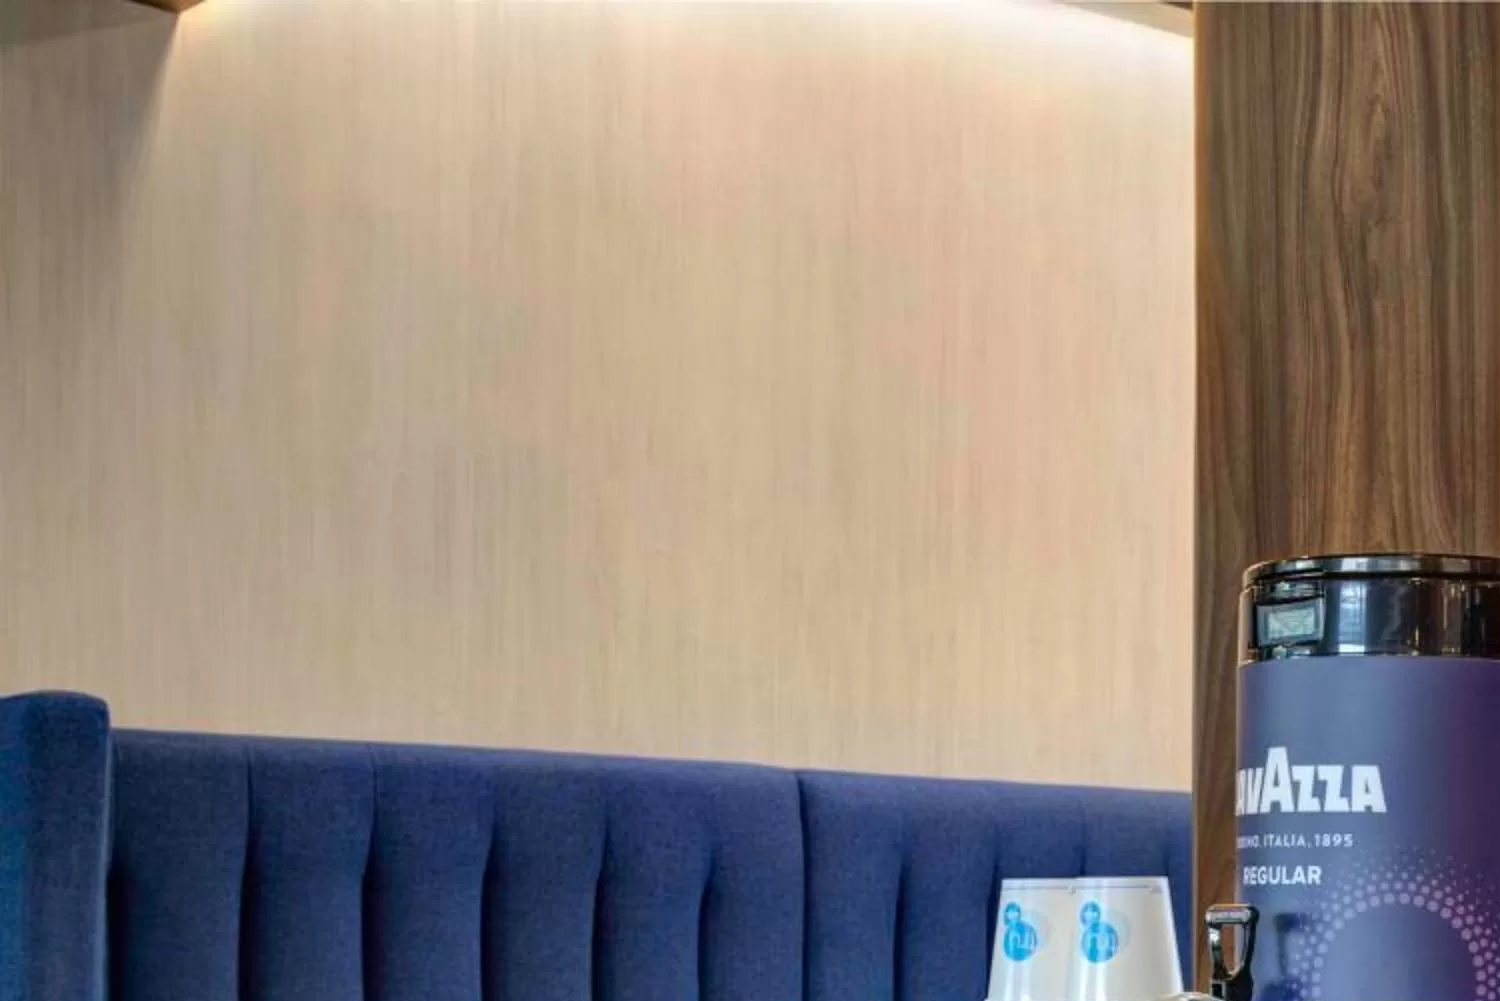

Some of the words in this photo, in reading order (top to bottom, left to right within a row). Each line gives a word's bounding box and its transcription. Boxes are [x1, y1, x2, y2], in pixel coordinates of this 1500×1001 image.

[1235, 746, 1387, 816] AVAZZA
[1314, 833, 1353, 848] 1895
[1243, 865, 1322, 885] REGULAR
